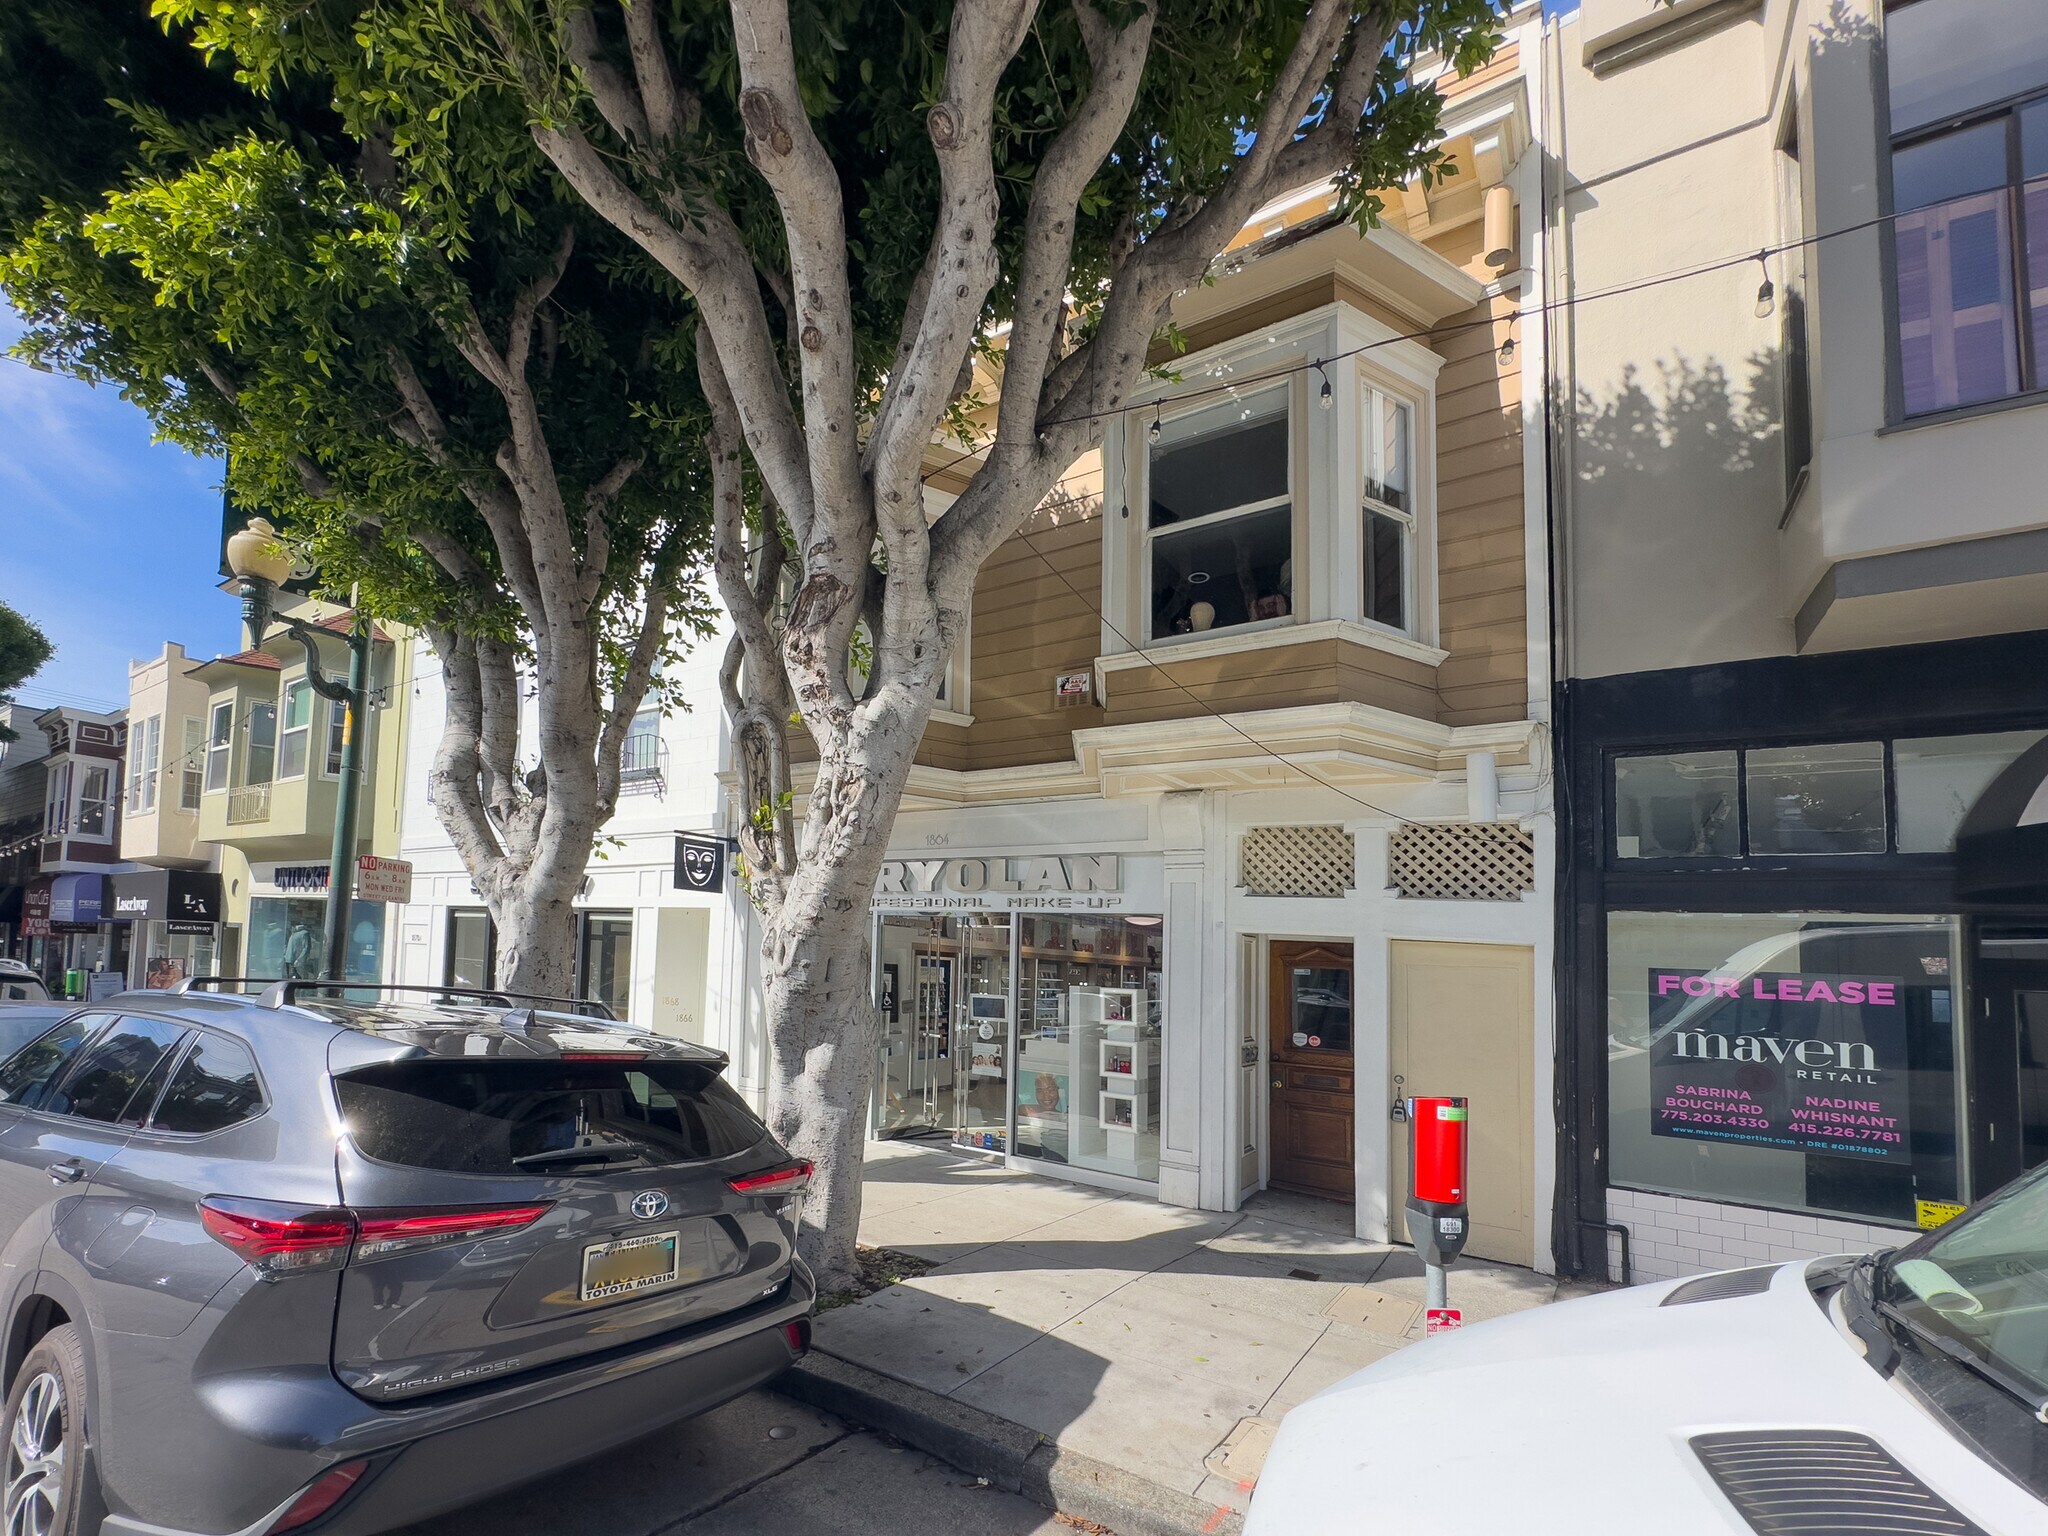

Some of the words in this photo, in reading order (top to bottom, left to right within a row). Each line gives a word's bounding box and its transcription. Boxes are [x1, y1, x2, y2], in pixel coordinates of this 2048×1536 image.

[360, 856, 376, 869] NO
[378, 861, 410, 874] PARKING
[873, 855, 1121, 892] RYOLAN
[364, 871, 371, 880] 6
[392, 874, 398, 883] 8
[365, 882, 379, 891] MON
[380, 884, 394, 893] WED
[395, 886, 405, 894] FRI
[116, 896, 149, 916] LaserAway
[872, 897, 991, 908] FESSIONAL
[1007, 897, 1121, 908] MAKE-UP
[27, 918, 50, 927] YOG
[169, 924, 212, 932] LaserAway
[1658, 974, 1740, 998] FOR
[1753, 978, 1896, 1006] LEASE
[676, 1013, 693, 1023] 1866
[1671, 1030, 1881, 1072] maven
[1796, 1069, 1877, 1085] RETAIL
[1675, 1085, 1752, 1101] SABRINA
[1665, 1097, 1763, 1115] BOUCHARD
[1805, 1096, 1881, 1113] NADINE
[1660, 1109, 1770, 1129] 775.203.4330
[1791, 1108, 1897, 1128] WHISNANT
[1672, 1126, 1796, 1146] www.mavenproperties.com
[1807, 1140, 1828, 1149] DRE
[1788, 1122, 1901, 1143] 415.226.7781
[586, 1282, 632, 1299] TOYOTA
[637, 1273, 675, 1288] MARIN
[384, 1358, 520, 1394] HIGHLANDER
